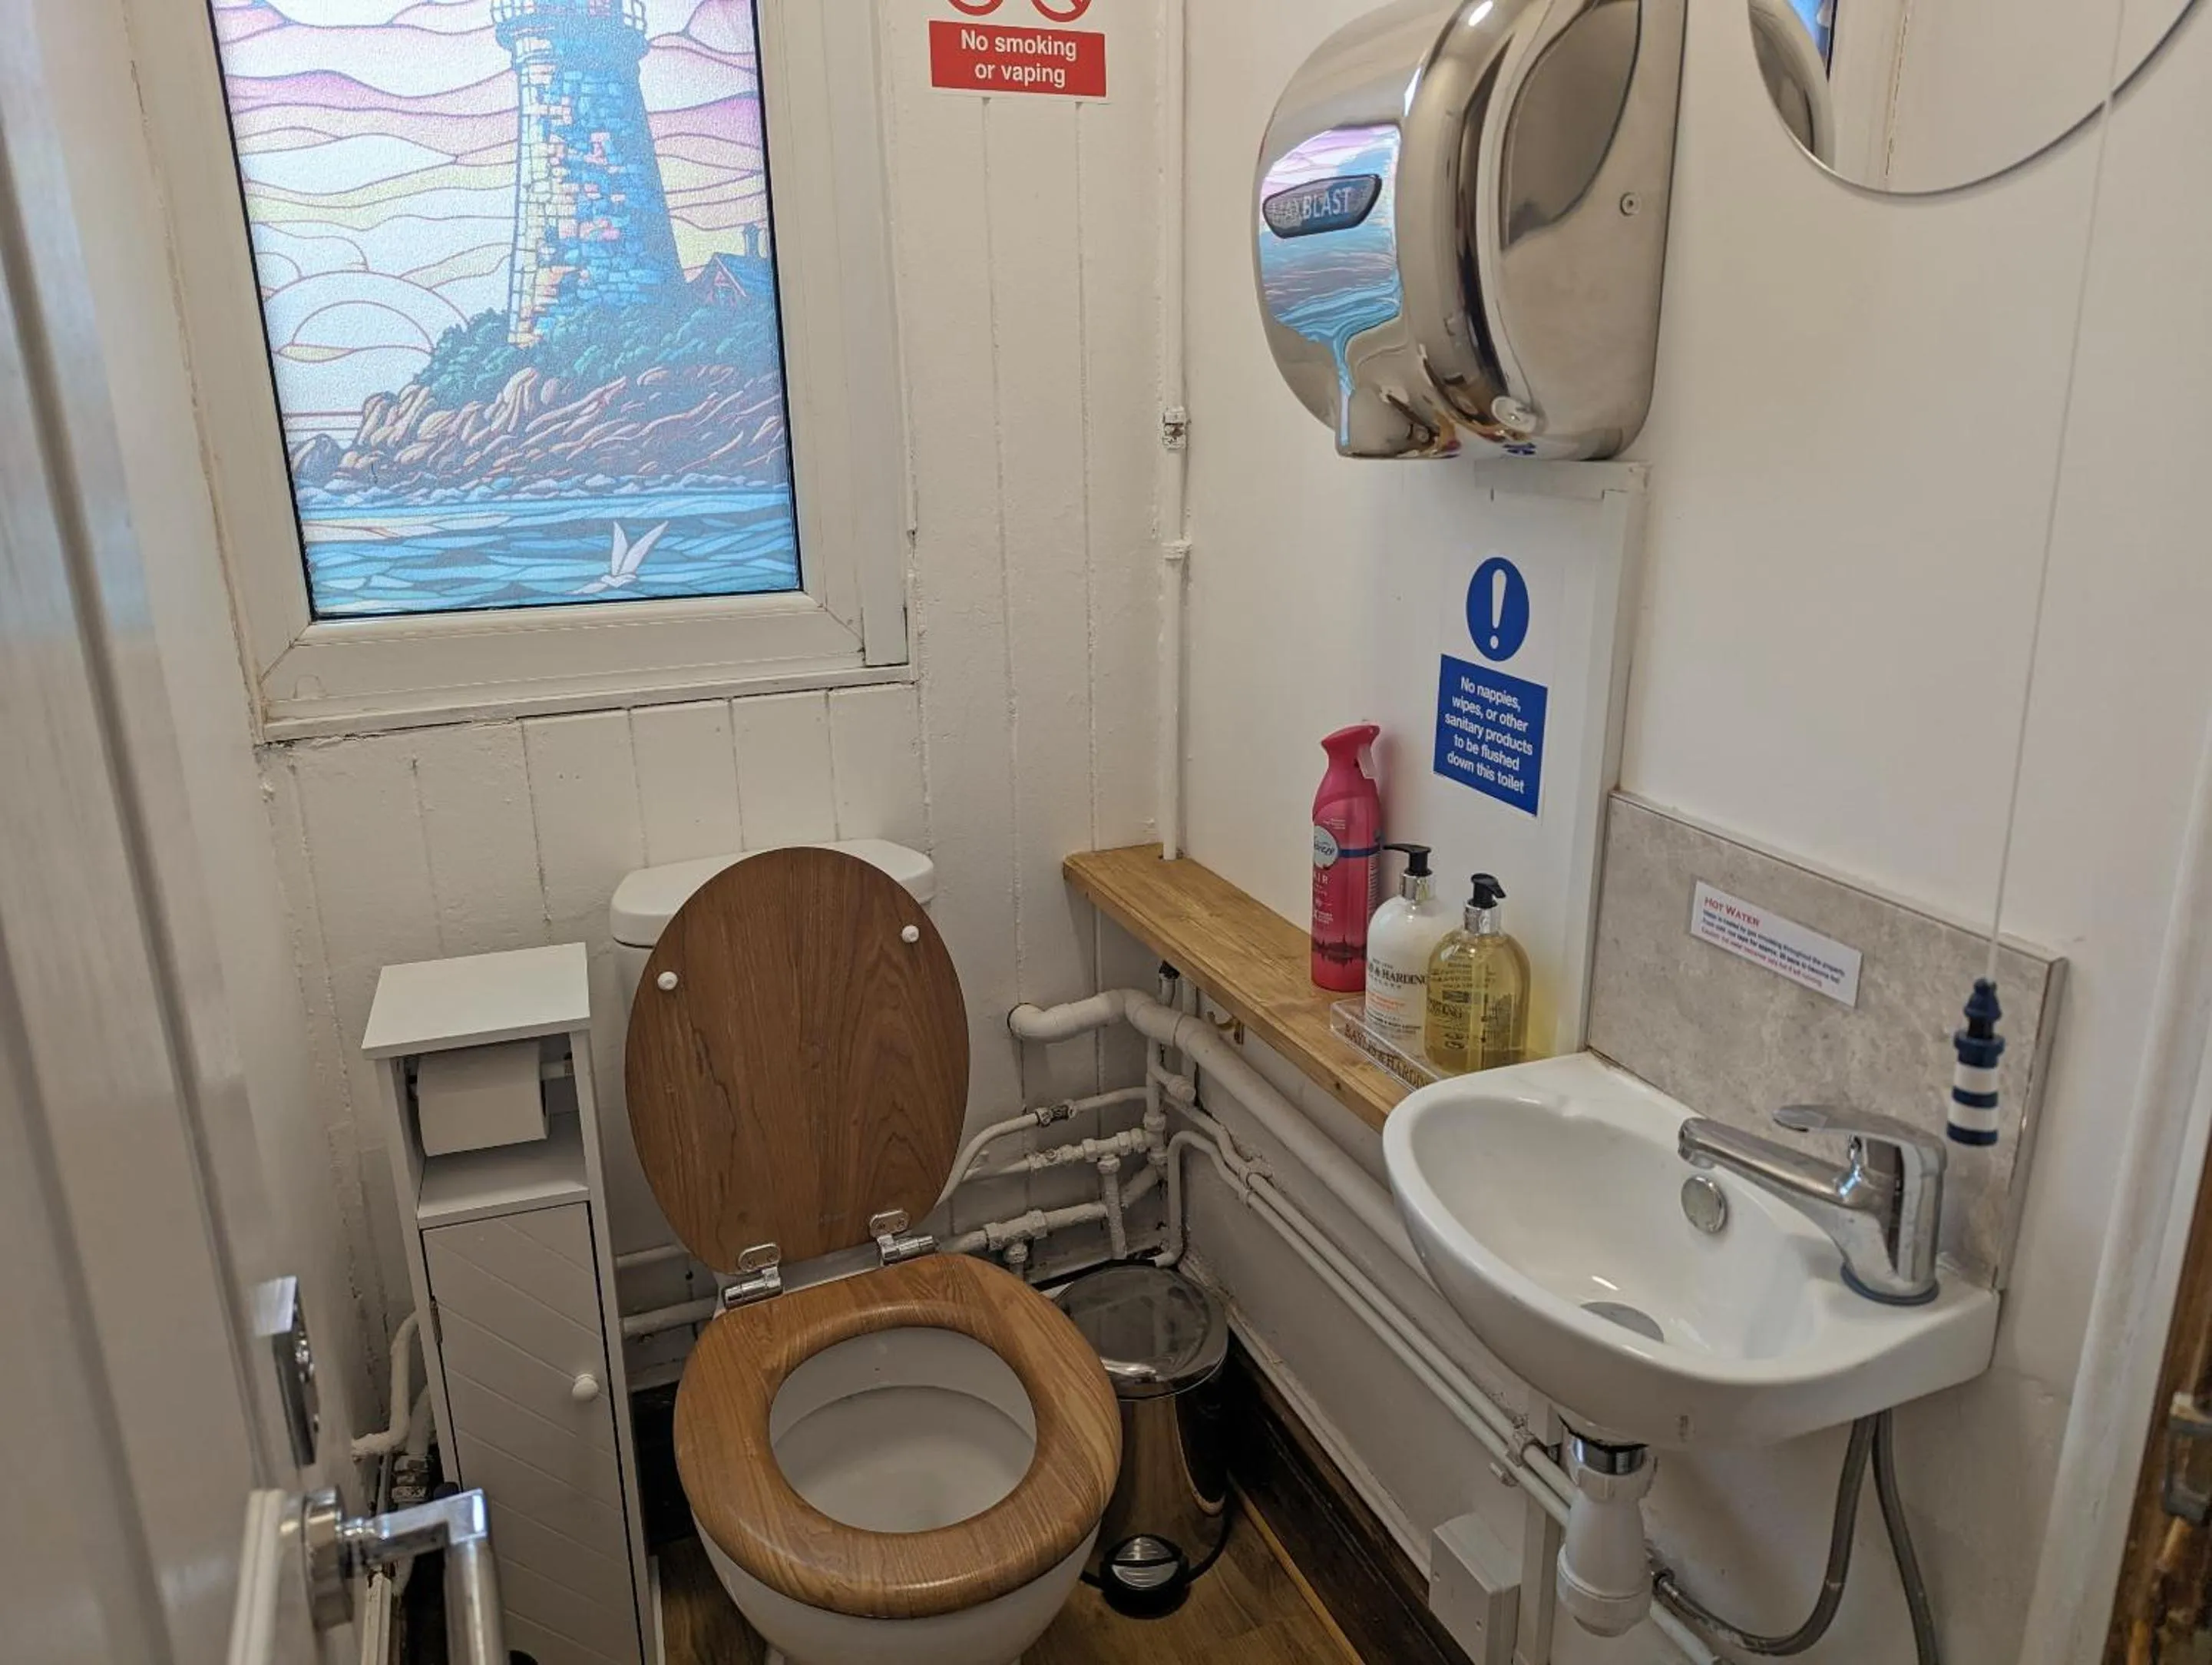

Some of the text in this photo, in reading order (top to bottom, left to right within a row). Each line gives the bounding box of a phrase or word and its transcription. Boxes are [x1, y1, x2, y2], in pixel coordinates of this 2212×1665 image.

[961, 29, 1076, 61] No smoking
[974, 63, 1066, 88] or vaping
[1460, 675, 1521, 713] No nappies,
[1452, 694, 1529, 733] wipes, or other
[1444, 713, 1533, 756] sanitary products
[1453, 733, 1520, 771] to be flushed
[1447, 750, 1525, 795] down this toilet
[1704, 896, 1761, 928] HOT WATER
[1382, 968, 1427, 985] HARDIN
